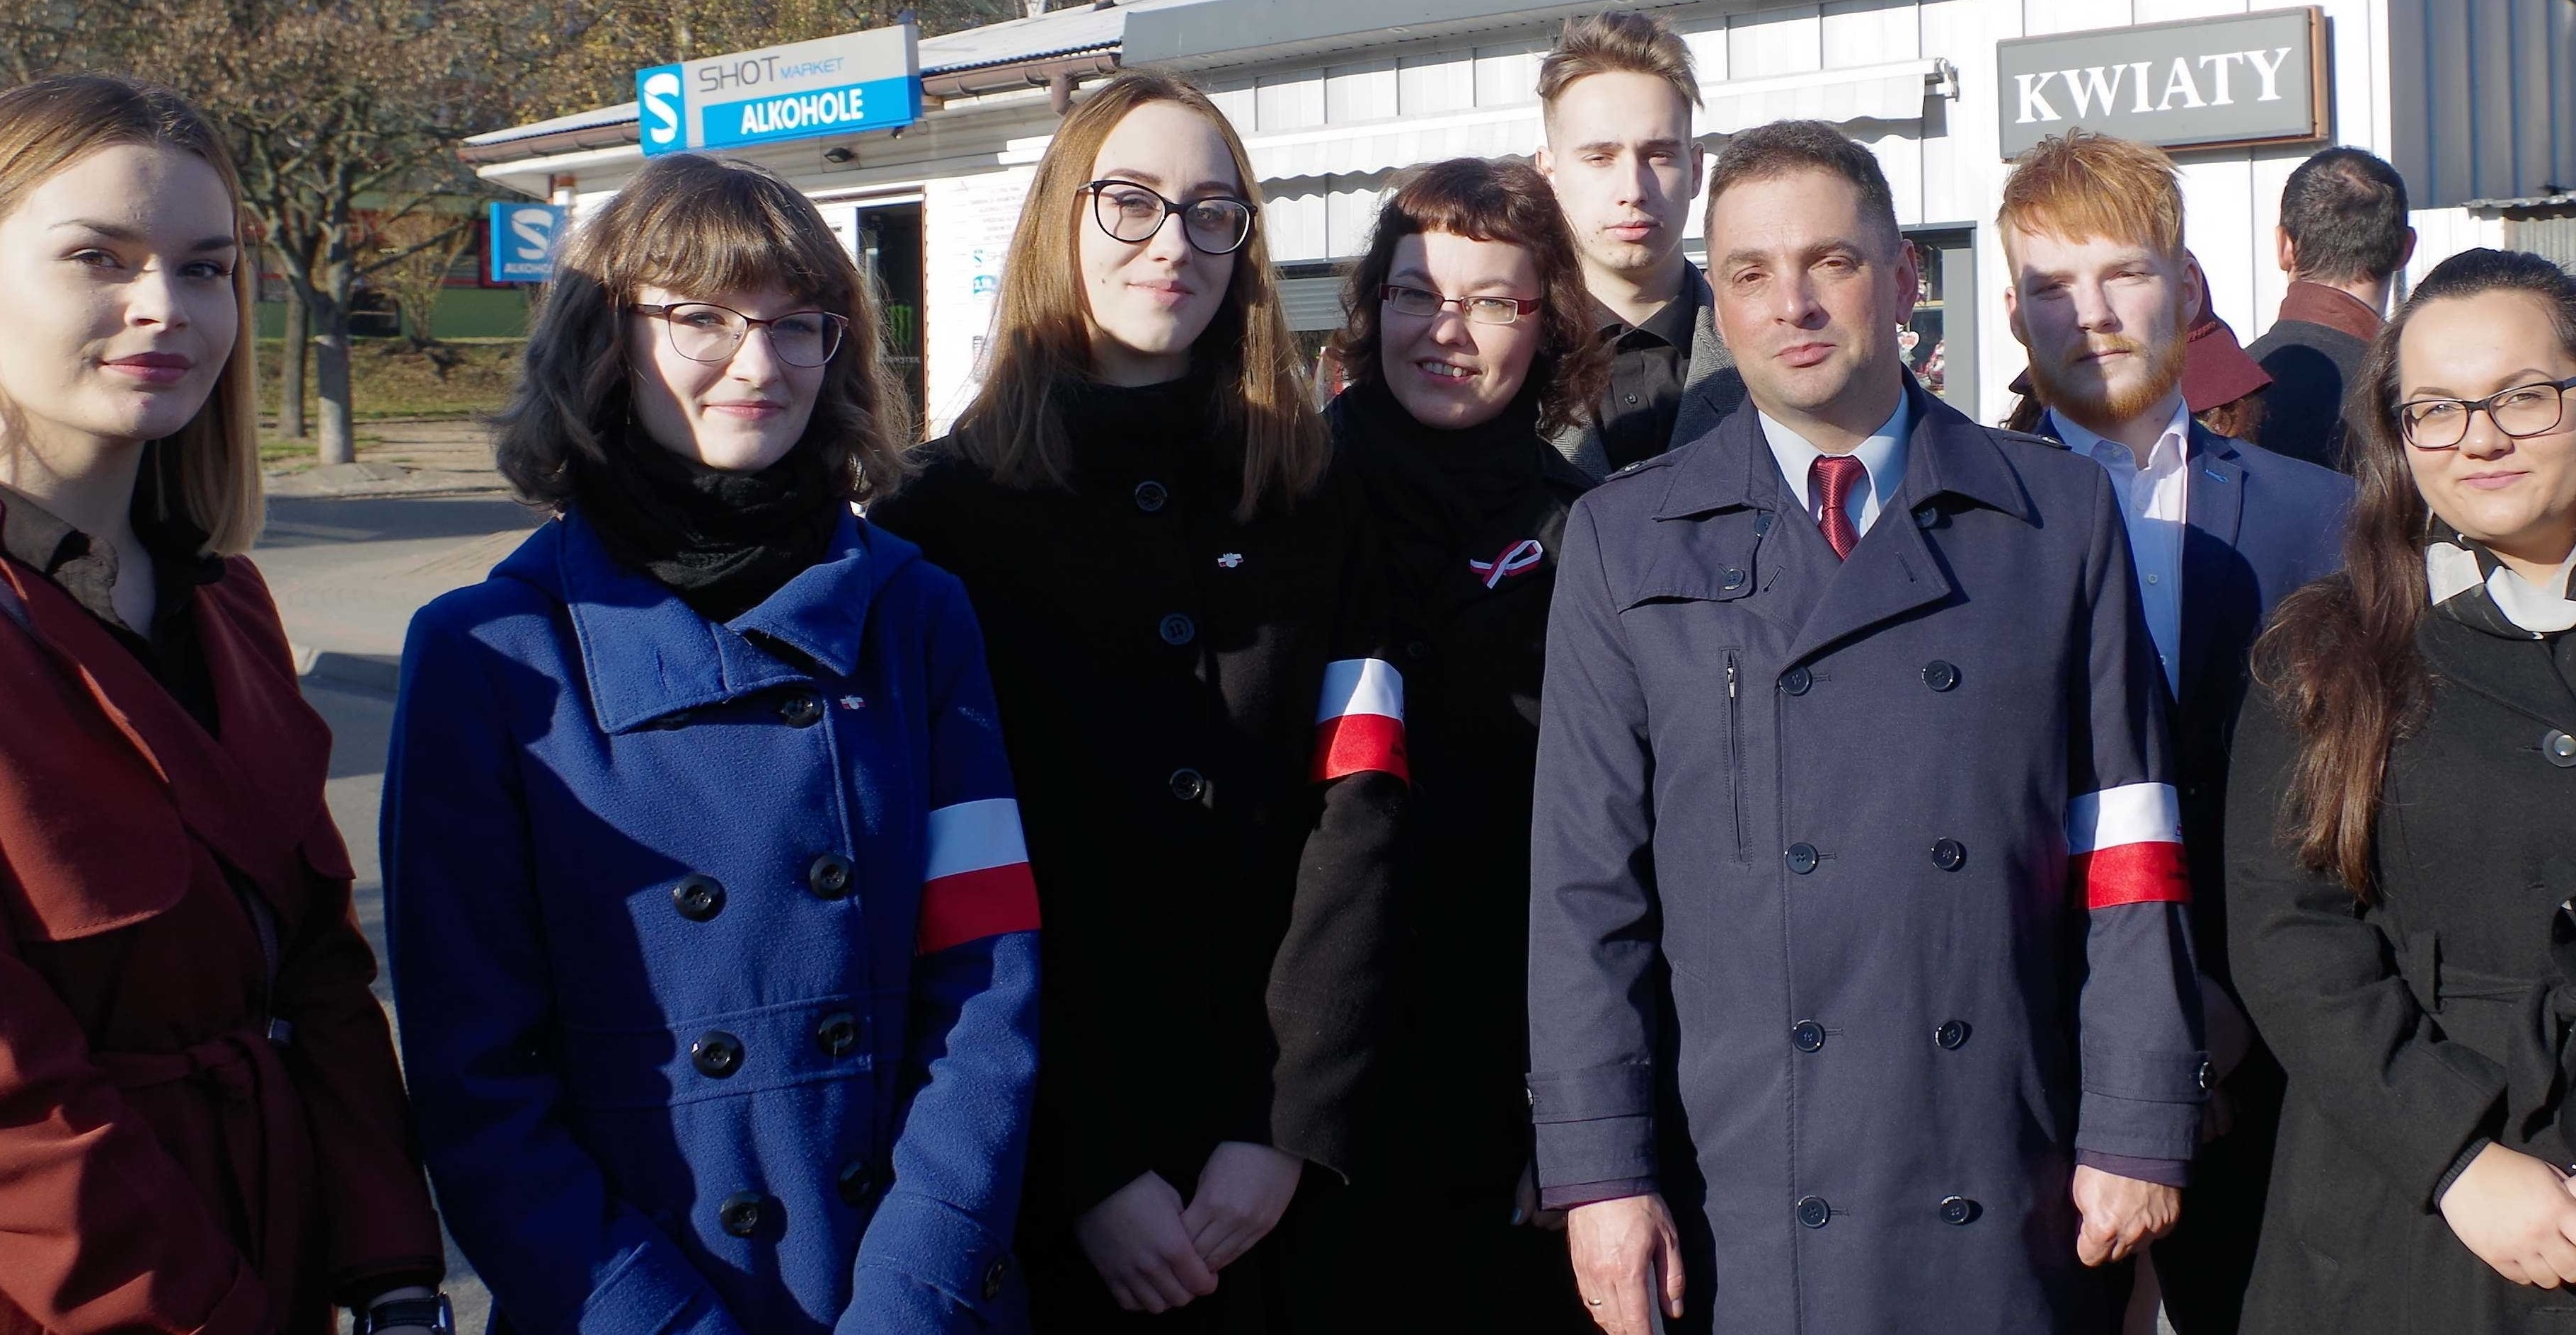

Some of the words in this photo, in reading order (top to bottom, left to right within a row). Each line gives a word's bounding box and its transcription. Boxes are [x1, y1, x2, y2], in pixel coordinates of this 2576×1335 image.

[699, 56, 780, 92] SHOT
[780, 57, 844, 79] MARKET
[2014, 47, 2292, 123] KWIATY
[740, 88, 864, 135] ALKOHOLE
